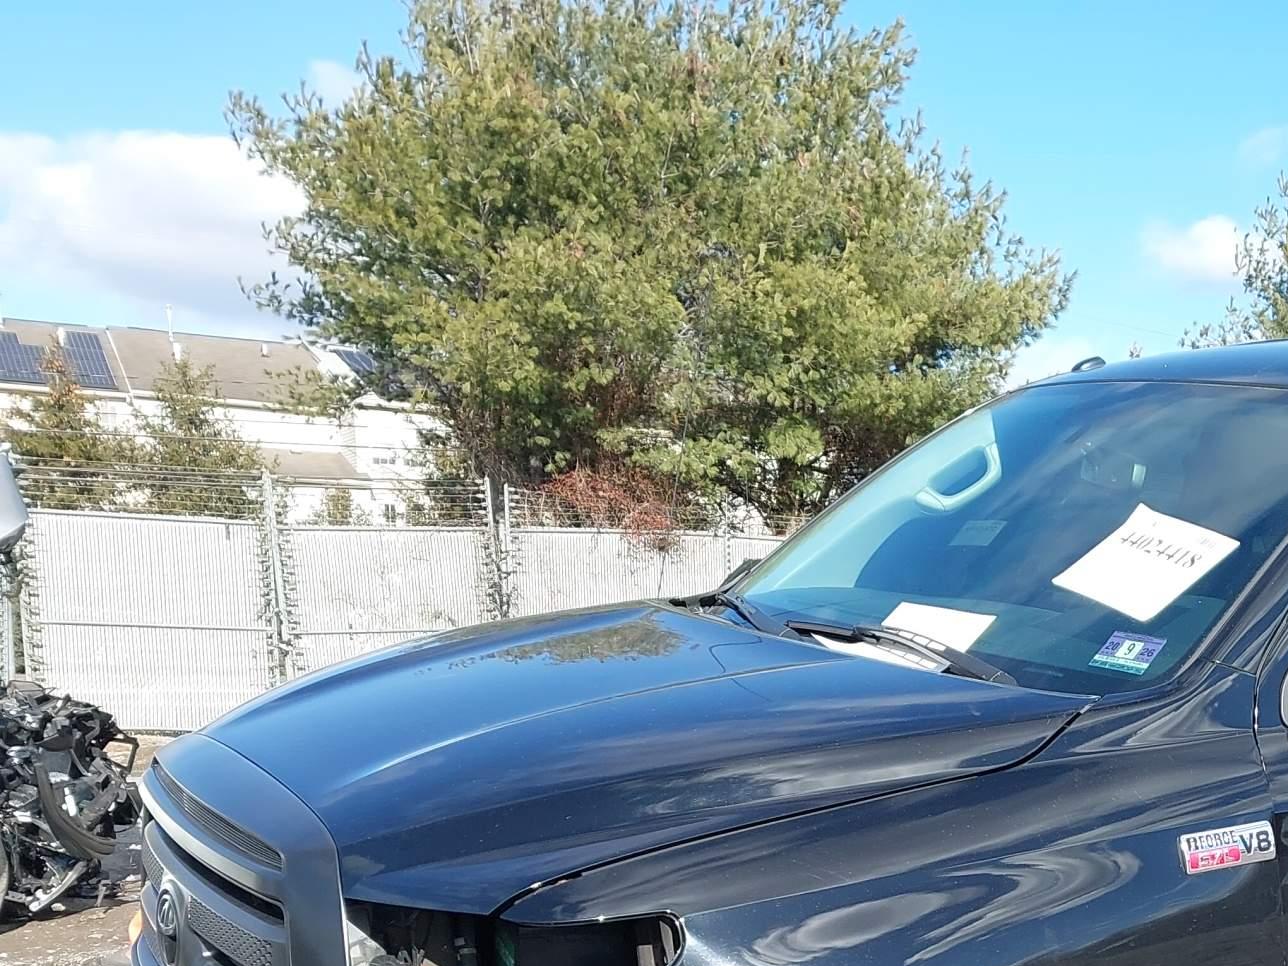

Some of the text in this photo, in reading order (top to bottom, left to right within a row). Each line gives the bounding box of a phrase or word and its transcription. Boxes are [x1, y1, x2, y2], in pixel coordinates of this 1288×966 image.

[1120, 531, 1202, 568] 44024418
[1105, 641, 1120, 651] 20
[1124, 642, 1136, 656] 9
[1140, 647, 1156, 658] 26
[1239, 830, 1272, 854] V8
